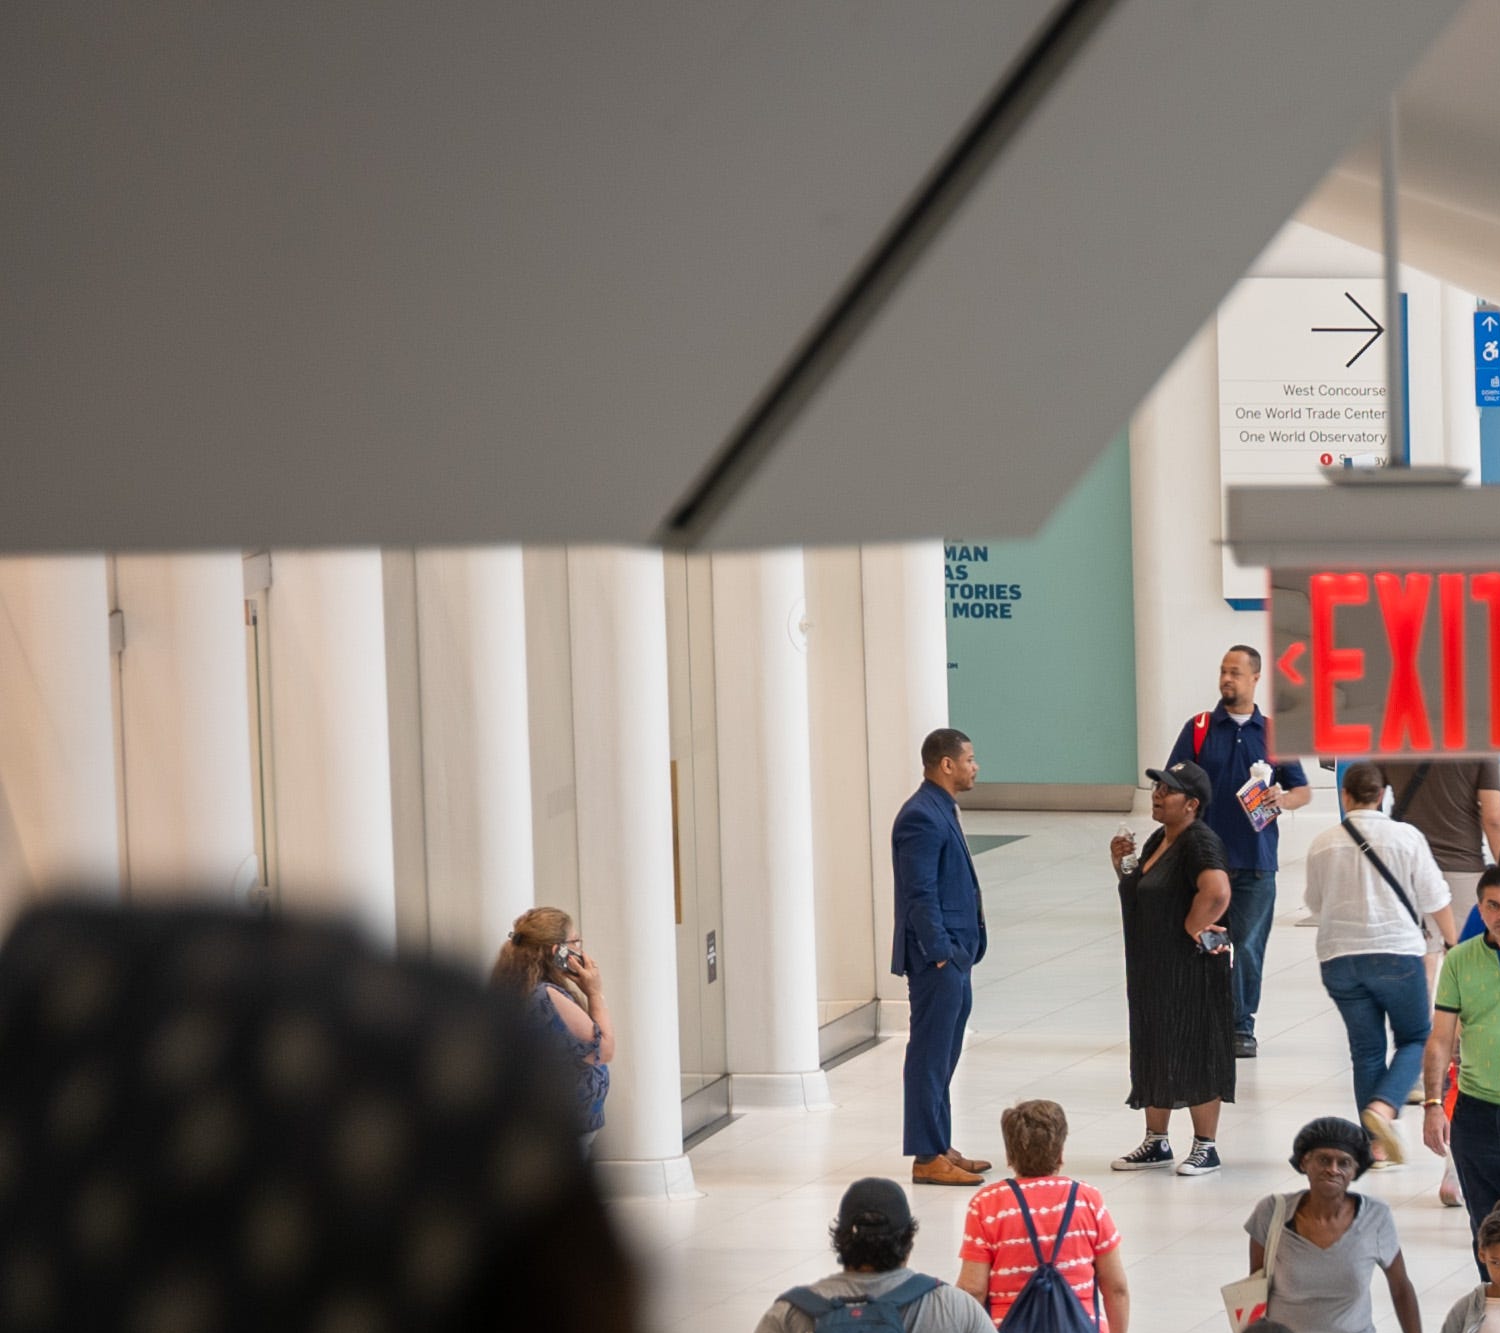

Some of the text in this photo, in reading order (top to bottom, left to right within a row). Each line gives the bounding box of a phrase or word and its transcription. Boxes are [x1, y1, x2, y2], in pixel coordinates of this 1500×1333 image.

[1283, 384, 1387, 397] West Concourse
[1235, 407, 1388, 420] One World Trade Center
[1239, 430, 1388, 445] One World Observatory
[953, 603, 1012, 619] MORE
